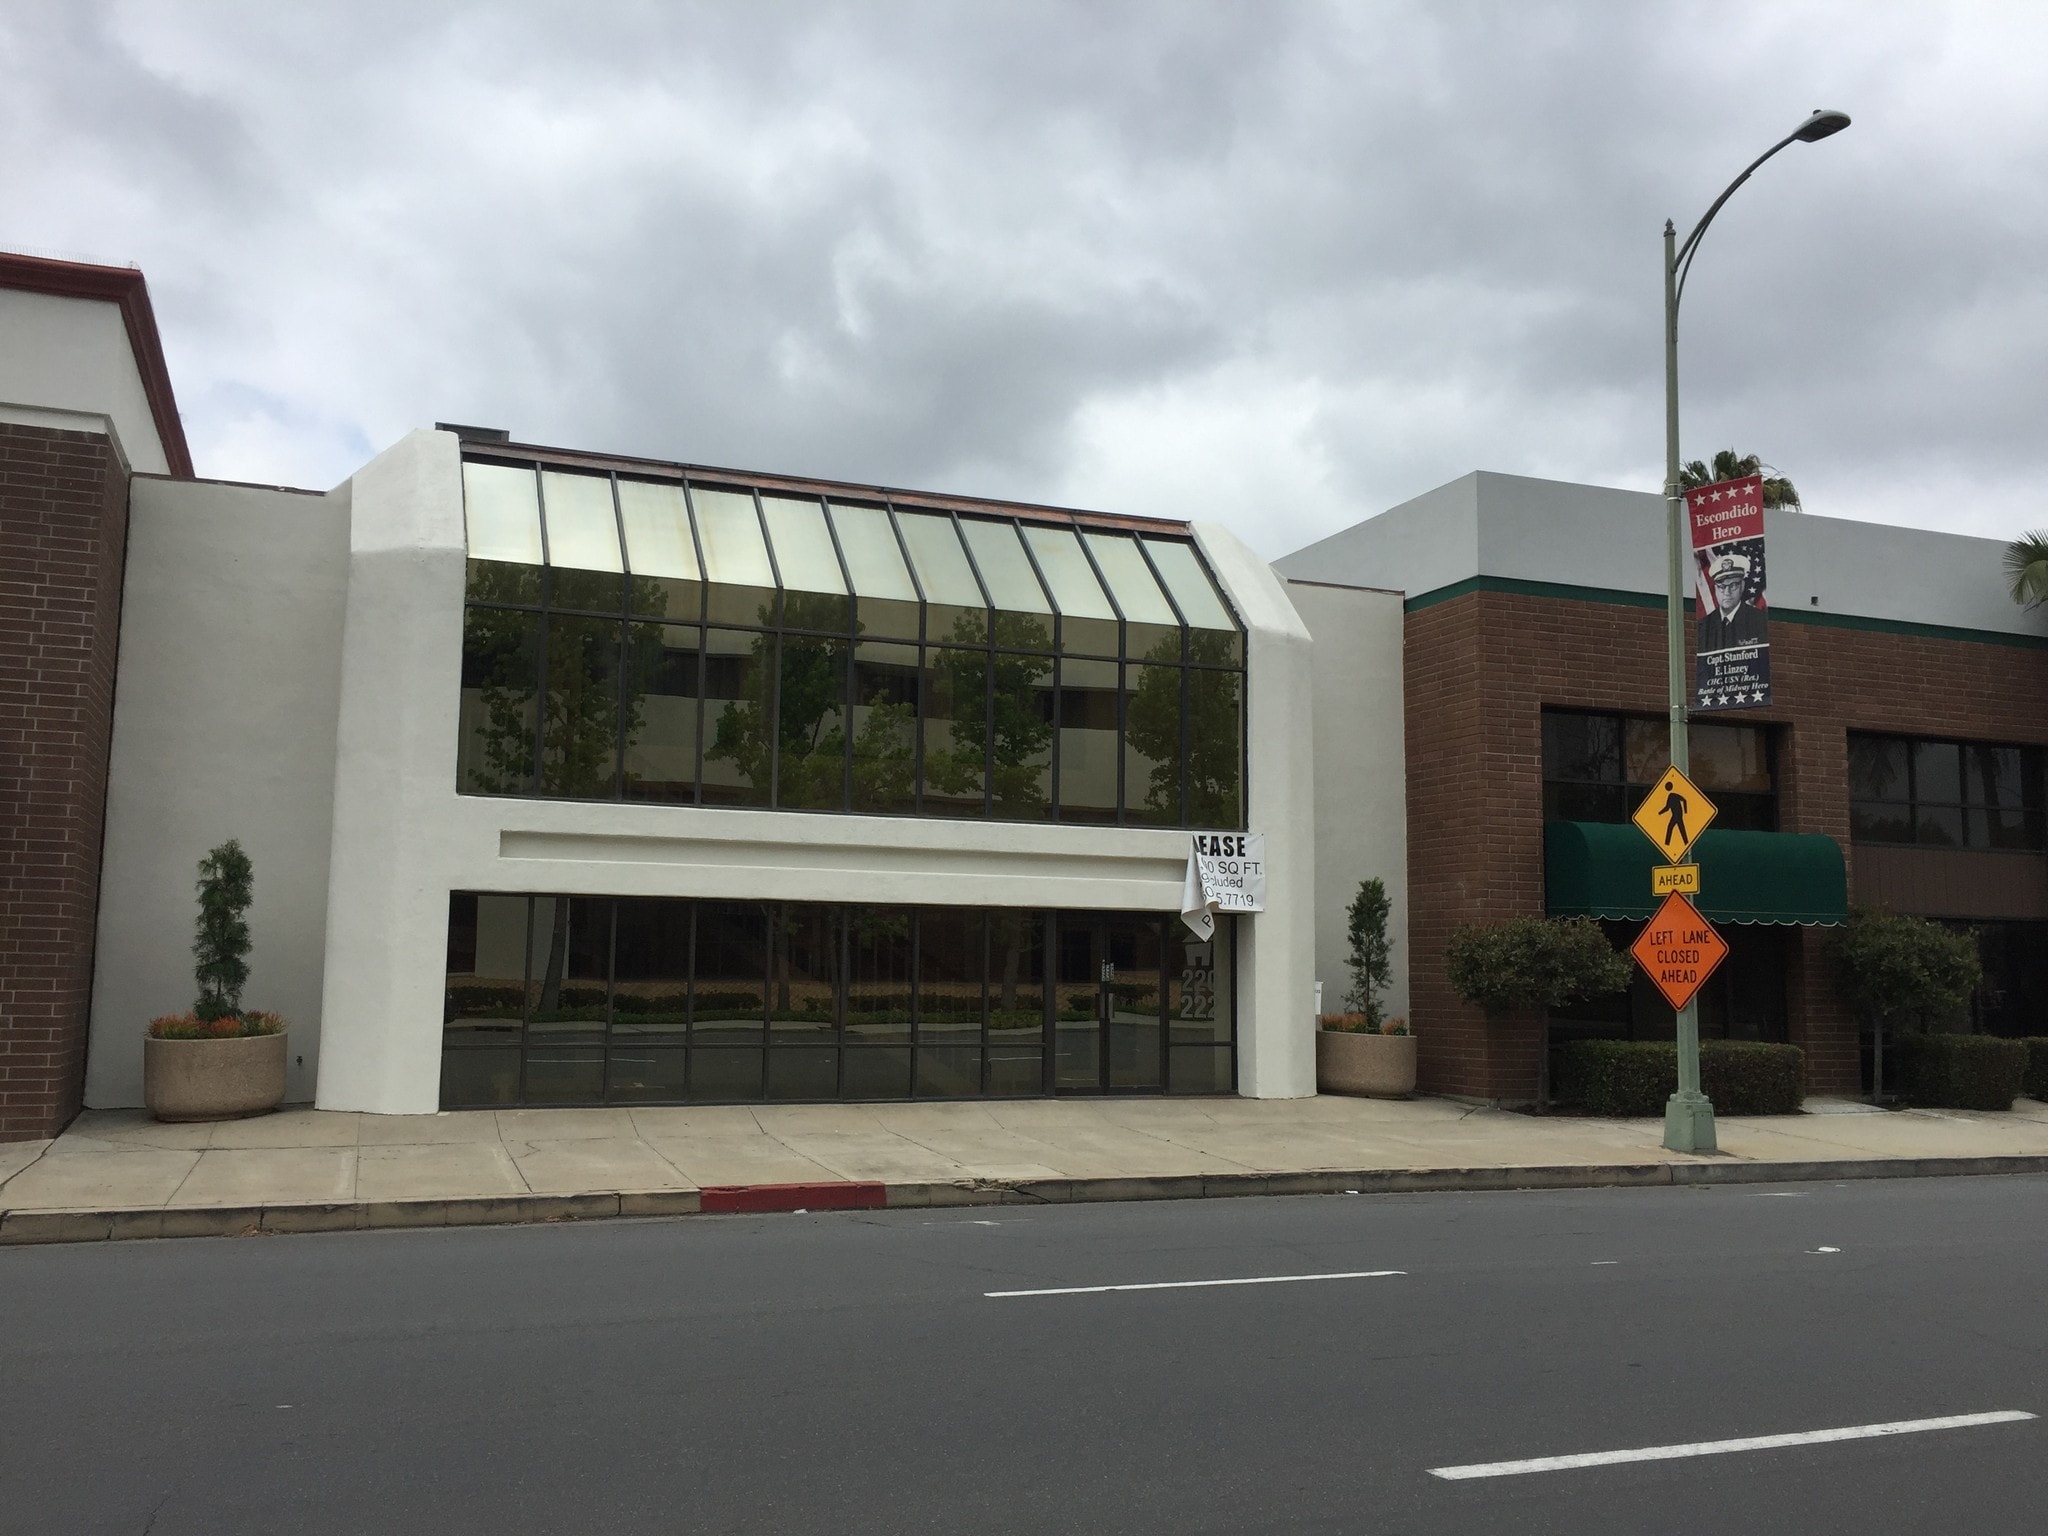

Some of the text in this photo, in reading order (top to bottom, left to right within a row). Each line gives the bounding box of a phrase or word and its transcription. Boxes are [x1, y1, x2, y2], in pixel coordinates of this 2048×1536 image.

[1695, 502, 1758, 527] Escondido
[1711, 524, 1742, 541] Hero
[1706, 648, 1759, 666] Capt. Stanford
[1714, 664, 1749, 676] E. Linzey
[1724, 676, 1740, 684] USN
[1716, 686, 1724, 694] of
[1725, 684, 1750, 693] Midway
[1751, 682, 1769, 690] Hero
[1197, 835, 1246, 857] EASE
[1218, 861, 1239, 875] SQ
[1243, 862, 1263, 875] FT.
[1659, 873, 1693, 886] AHEAD
[1216, 893, 1254, 906] 5.7719
[1650, 930, 1711, 946] LEFT LANE
[1657, 950, 1700, 964] CLOSED
[1660, 970, 1697, 983] AHEAD
